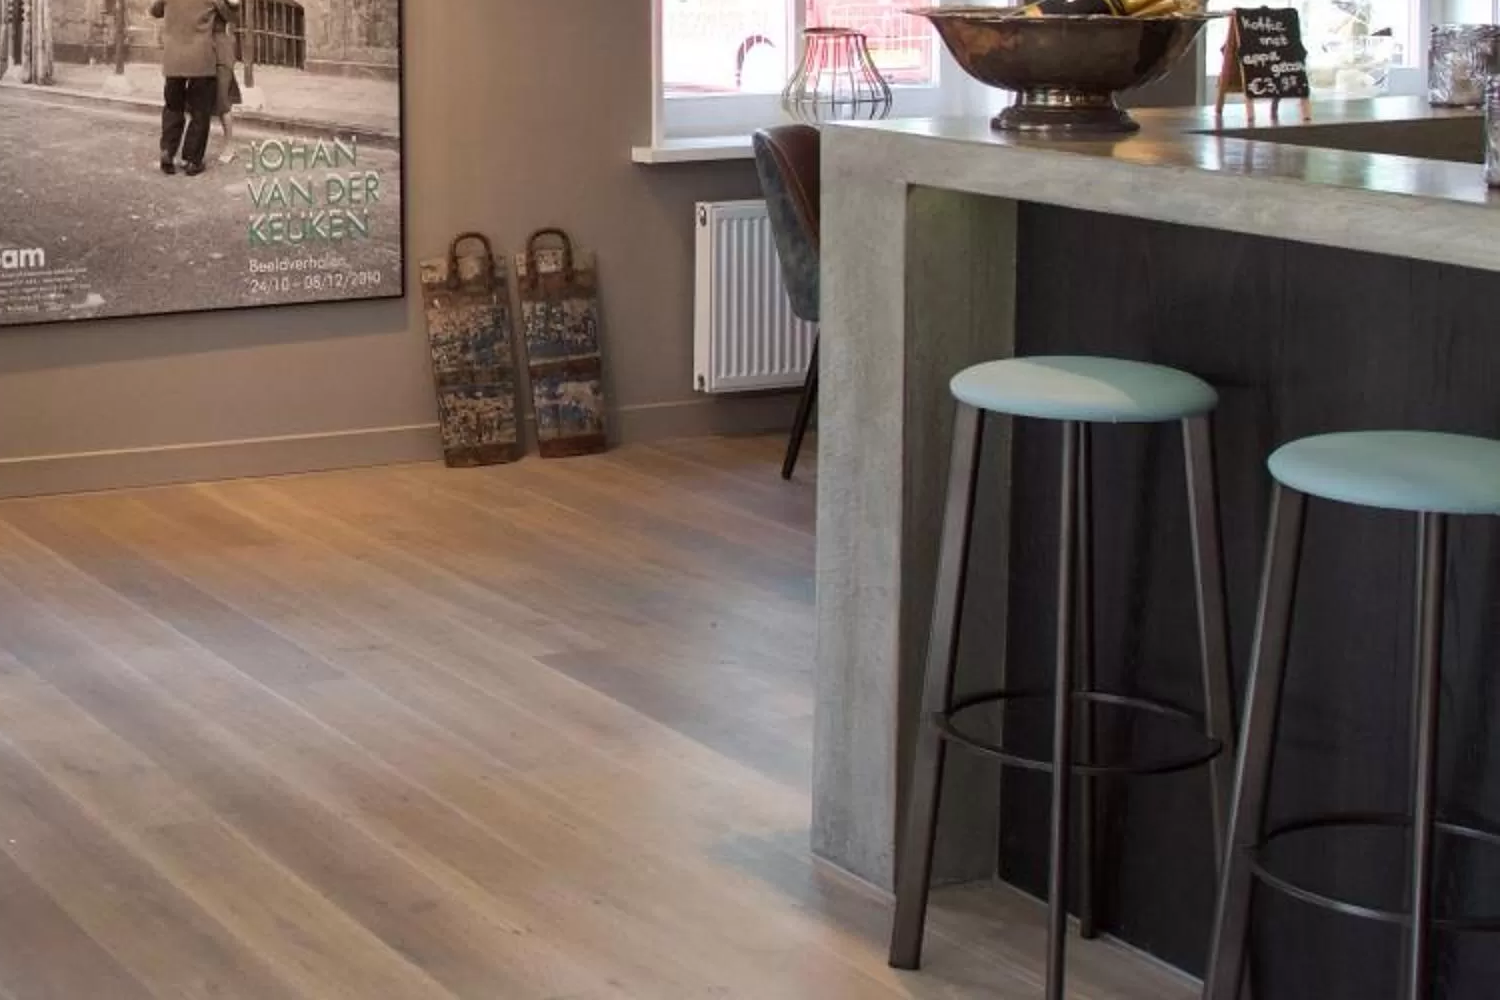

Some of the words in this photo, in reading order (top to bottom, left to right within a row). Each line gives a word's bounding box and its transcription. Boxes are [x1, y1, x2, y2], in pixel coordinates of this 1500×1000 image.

[245, 135, 357, 172] JOHAN
[246, 174, 313, 208] VAN
[326, 170, 382, 203] DER
[248, 208, 369, 245] KEUKEN
